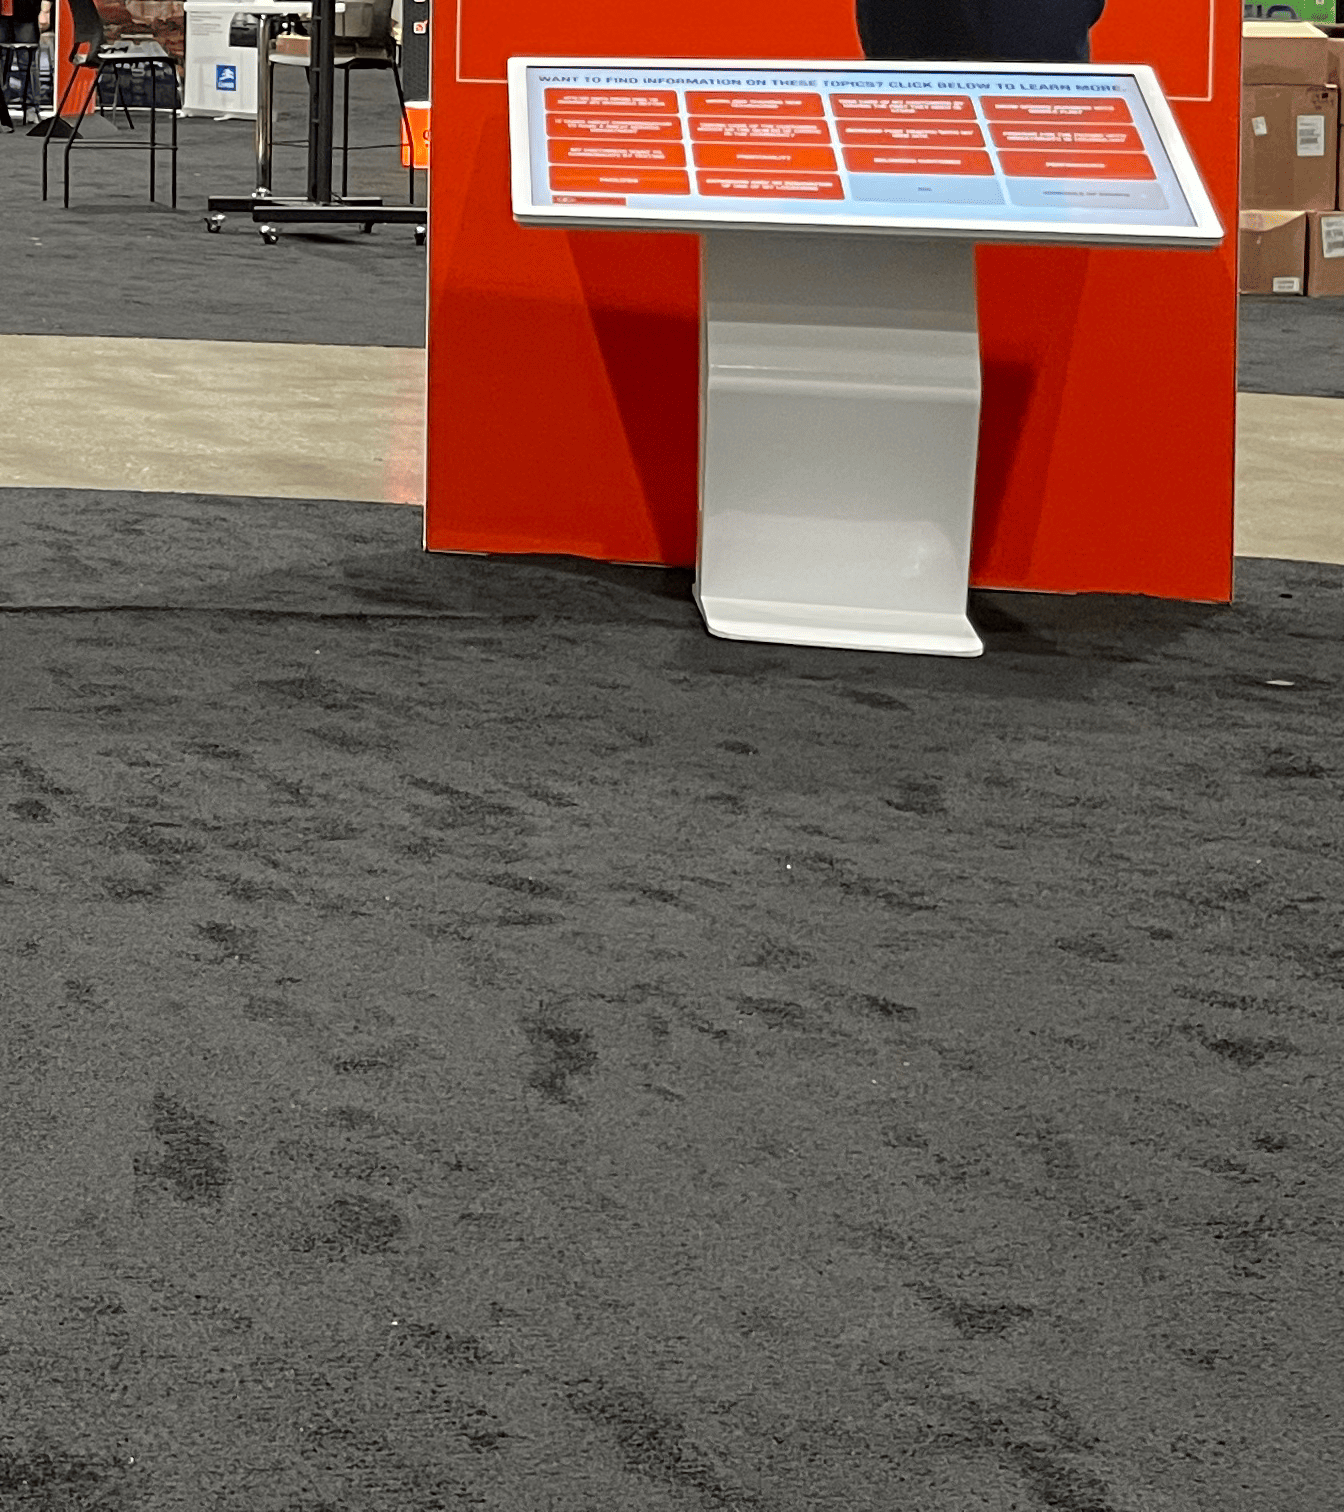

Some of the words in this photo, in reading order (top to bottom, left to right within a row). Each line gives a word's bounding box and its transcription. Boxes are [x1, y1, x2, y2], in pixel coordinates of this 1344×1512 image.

[585, 76, 600, 84] TO
[606, 76, 638, 84] FIND
[644, 77, 740, 85] INFORMATION
[889, 81, 933, 89] CLICK
[938, 82, 991, 90] BELOW
